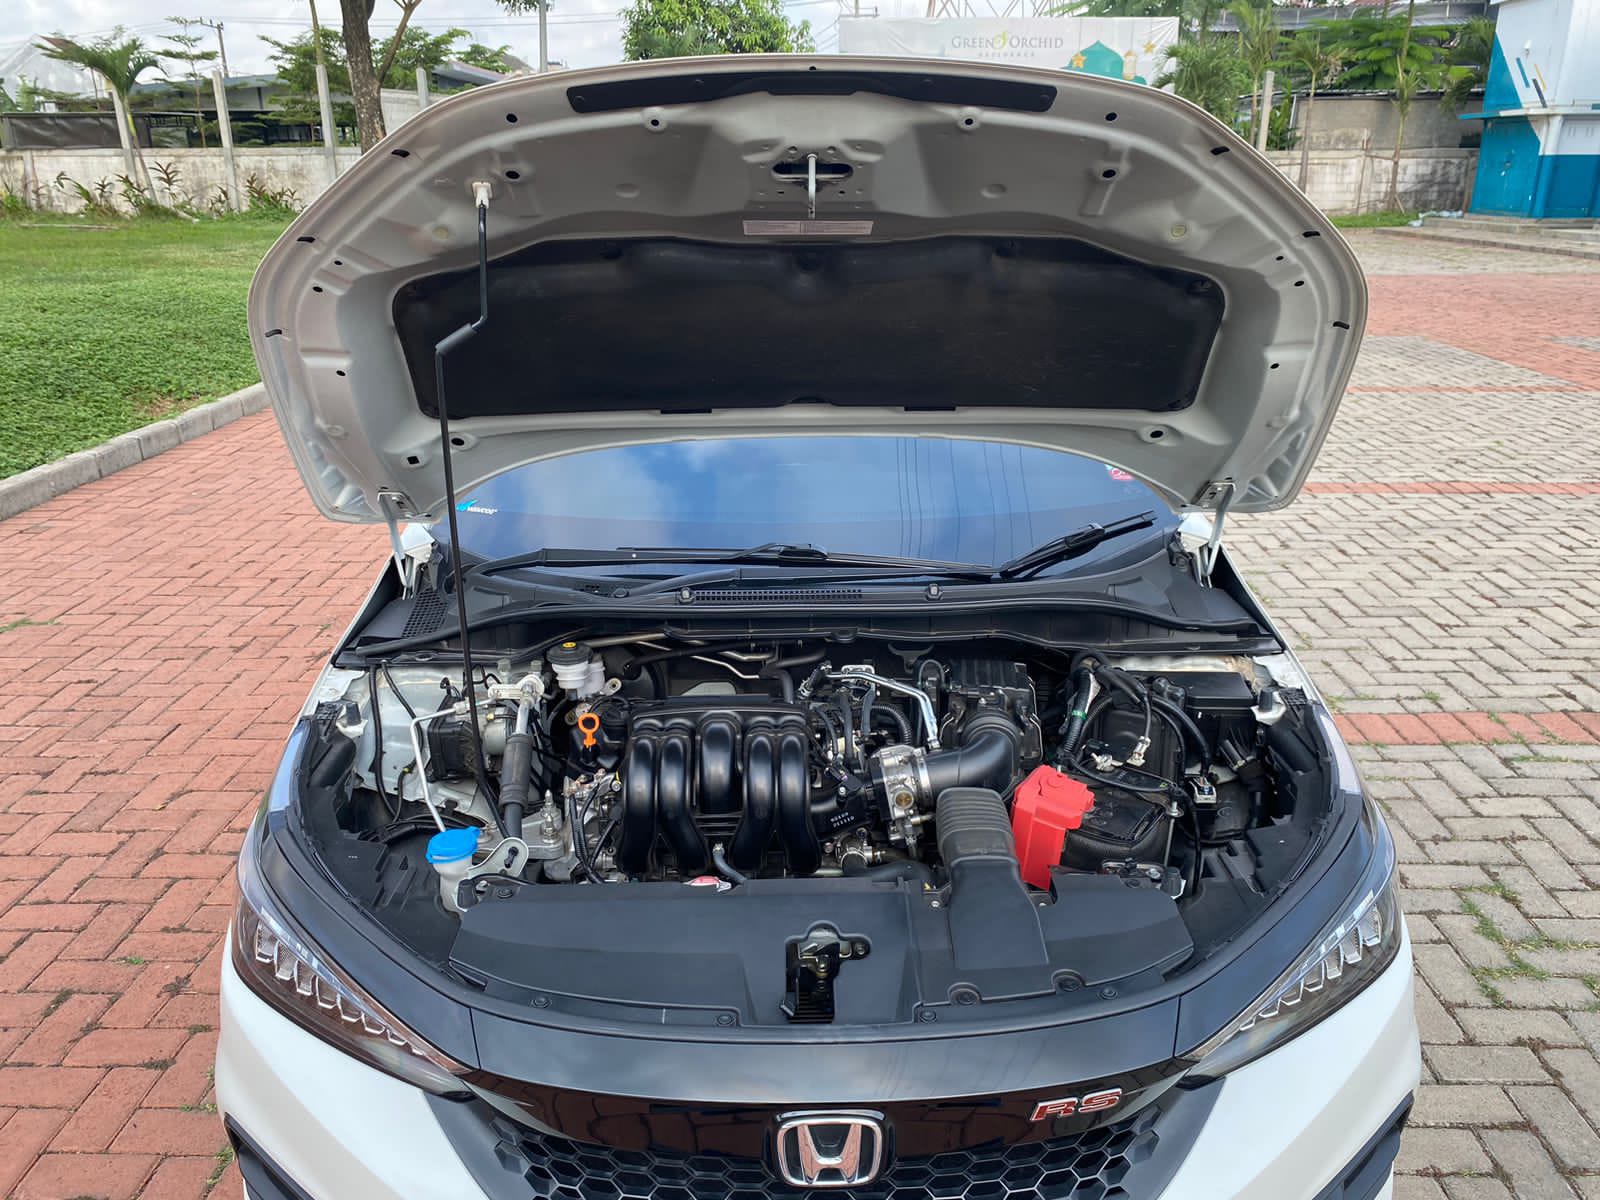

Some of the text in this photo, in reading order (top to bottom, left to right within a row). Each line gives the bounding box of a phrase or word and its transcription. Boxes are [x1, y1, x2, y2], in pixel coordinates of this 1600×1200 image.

[951, 35, 1064, 49] GREEN ORCHID
[1030, 1087, 1122, 1121] RS
